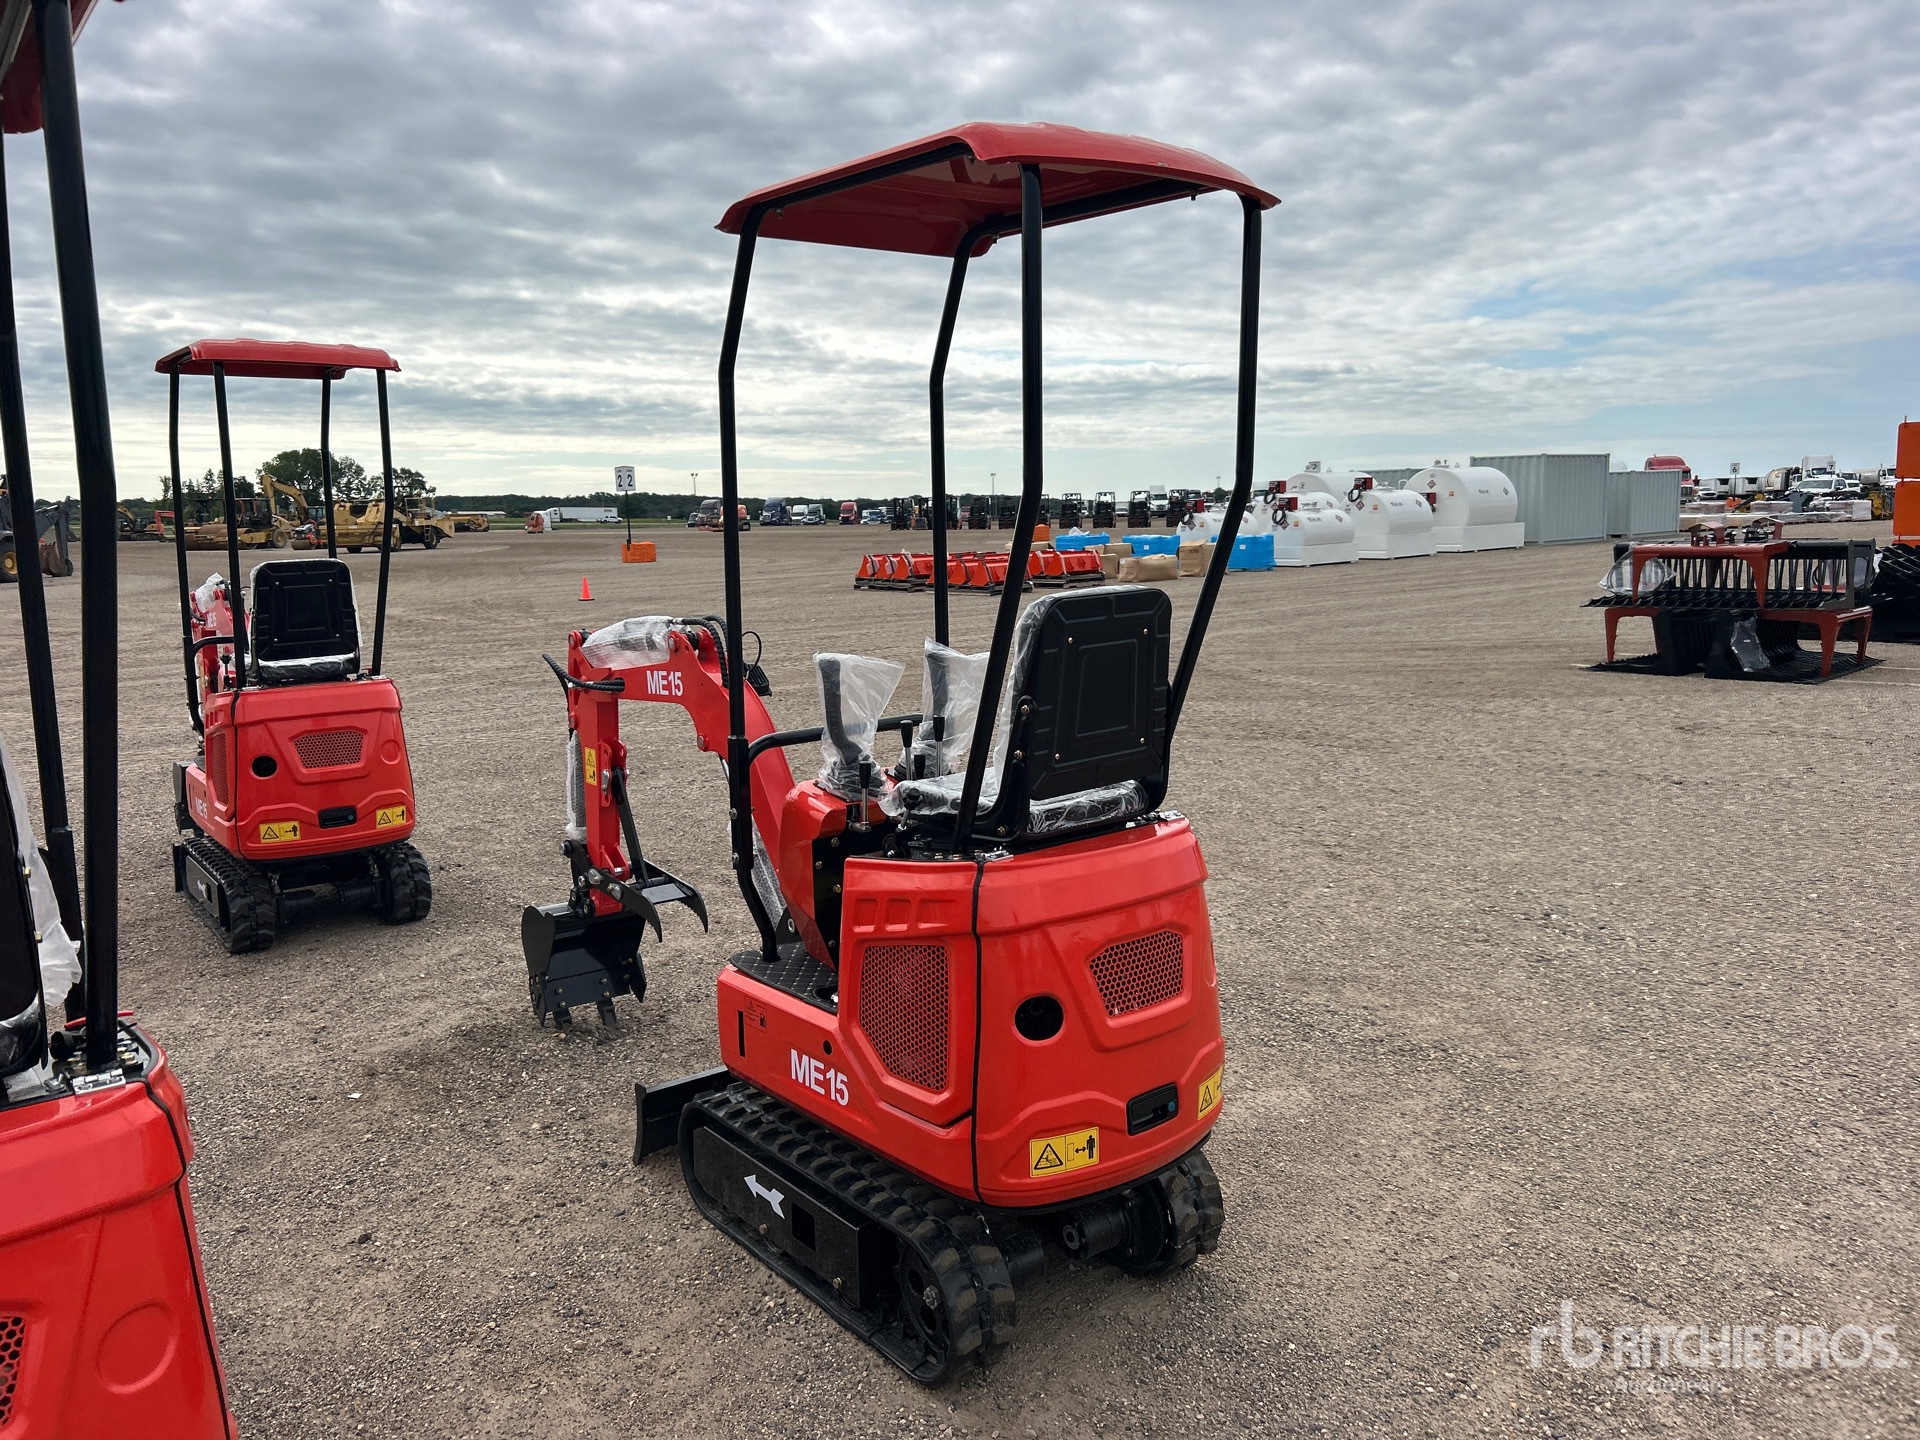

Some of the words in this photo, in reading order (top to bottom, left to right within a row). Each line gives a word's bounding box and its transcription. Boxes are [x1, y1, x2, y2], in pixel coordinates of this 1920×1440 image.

[617, 474, 623, 488] 2
[627, 474, 633, 487] 2
[646, 670, 684, 697] ME15
[790, 1048, 849, 1106] ME15
